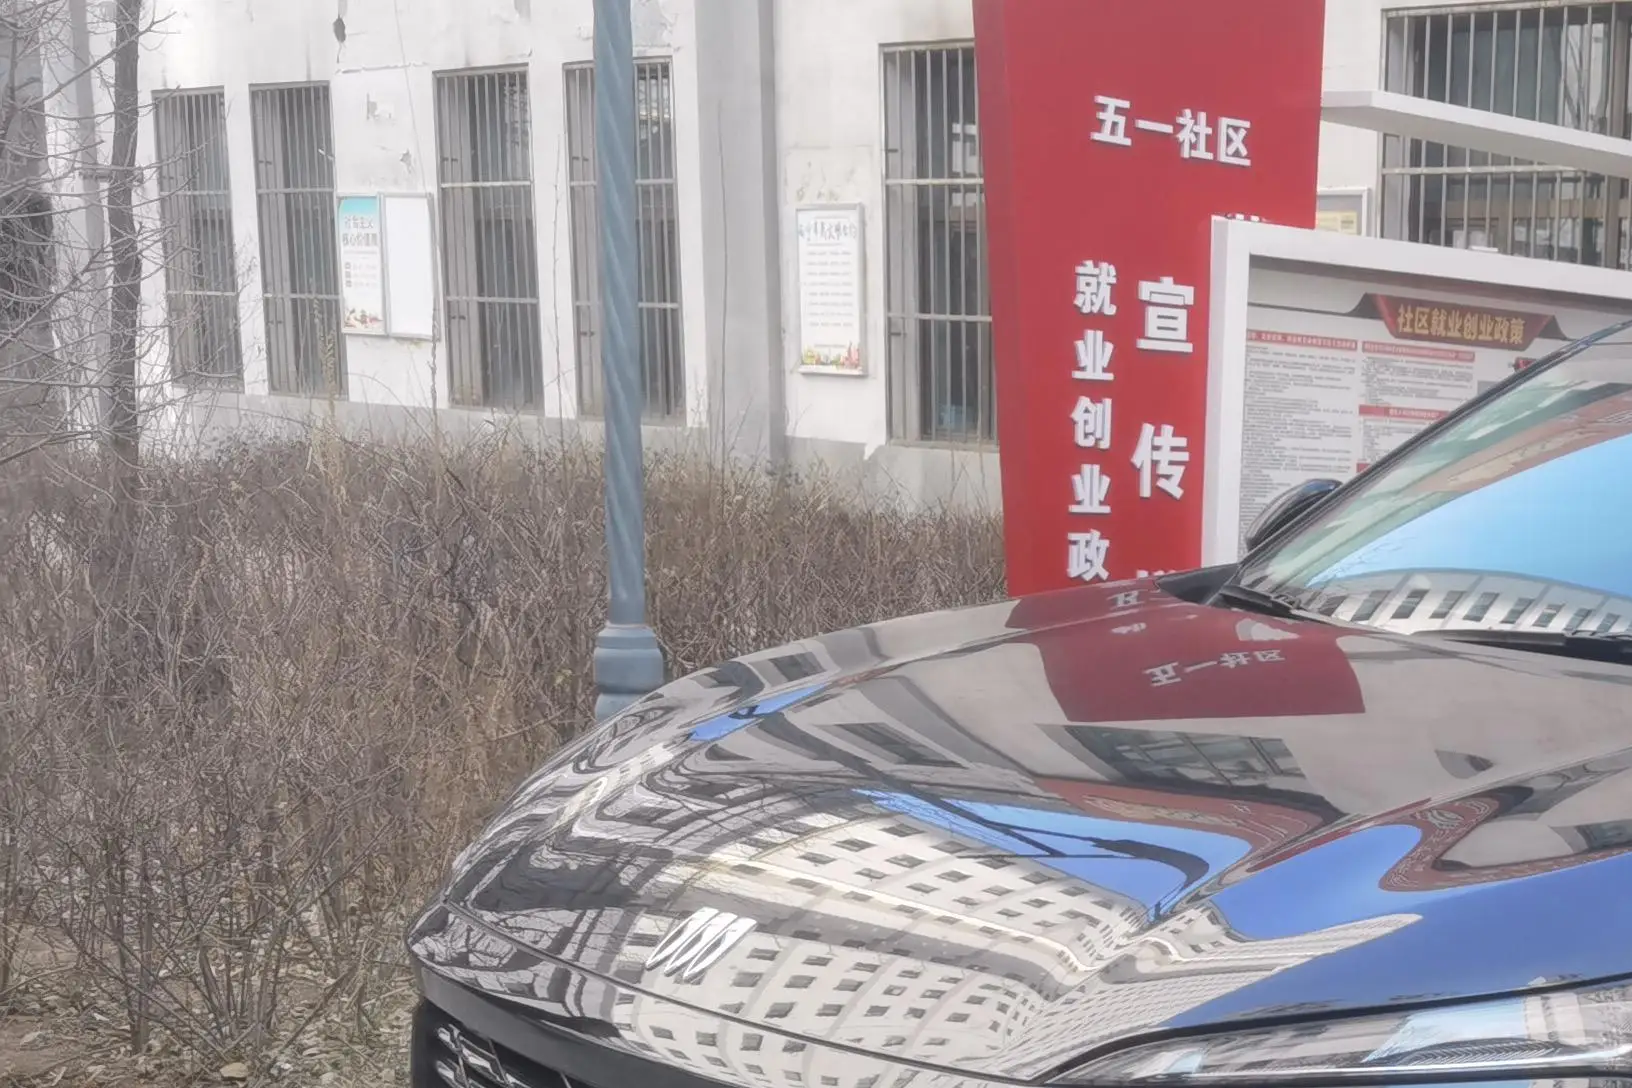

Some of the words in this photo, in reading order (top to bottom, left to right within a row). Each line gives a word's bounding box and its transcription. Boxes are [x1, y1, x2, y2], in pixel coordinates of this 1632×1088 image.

[1090, 95, 1251, 166] 五一社区
[1397, 304, 1526, 344] 社区就业创业政策
[1067, 260, 1117, 582] 就业创业政
[1131, 277, 1194, 579] 宣传
